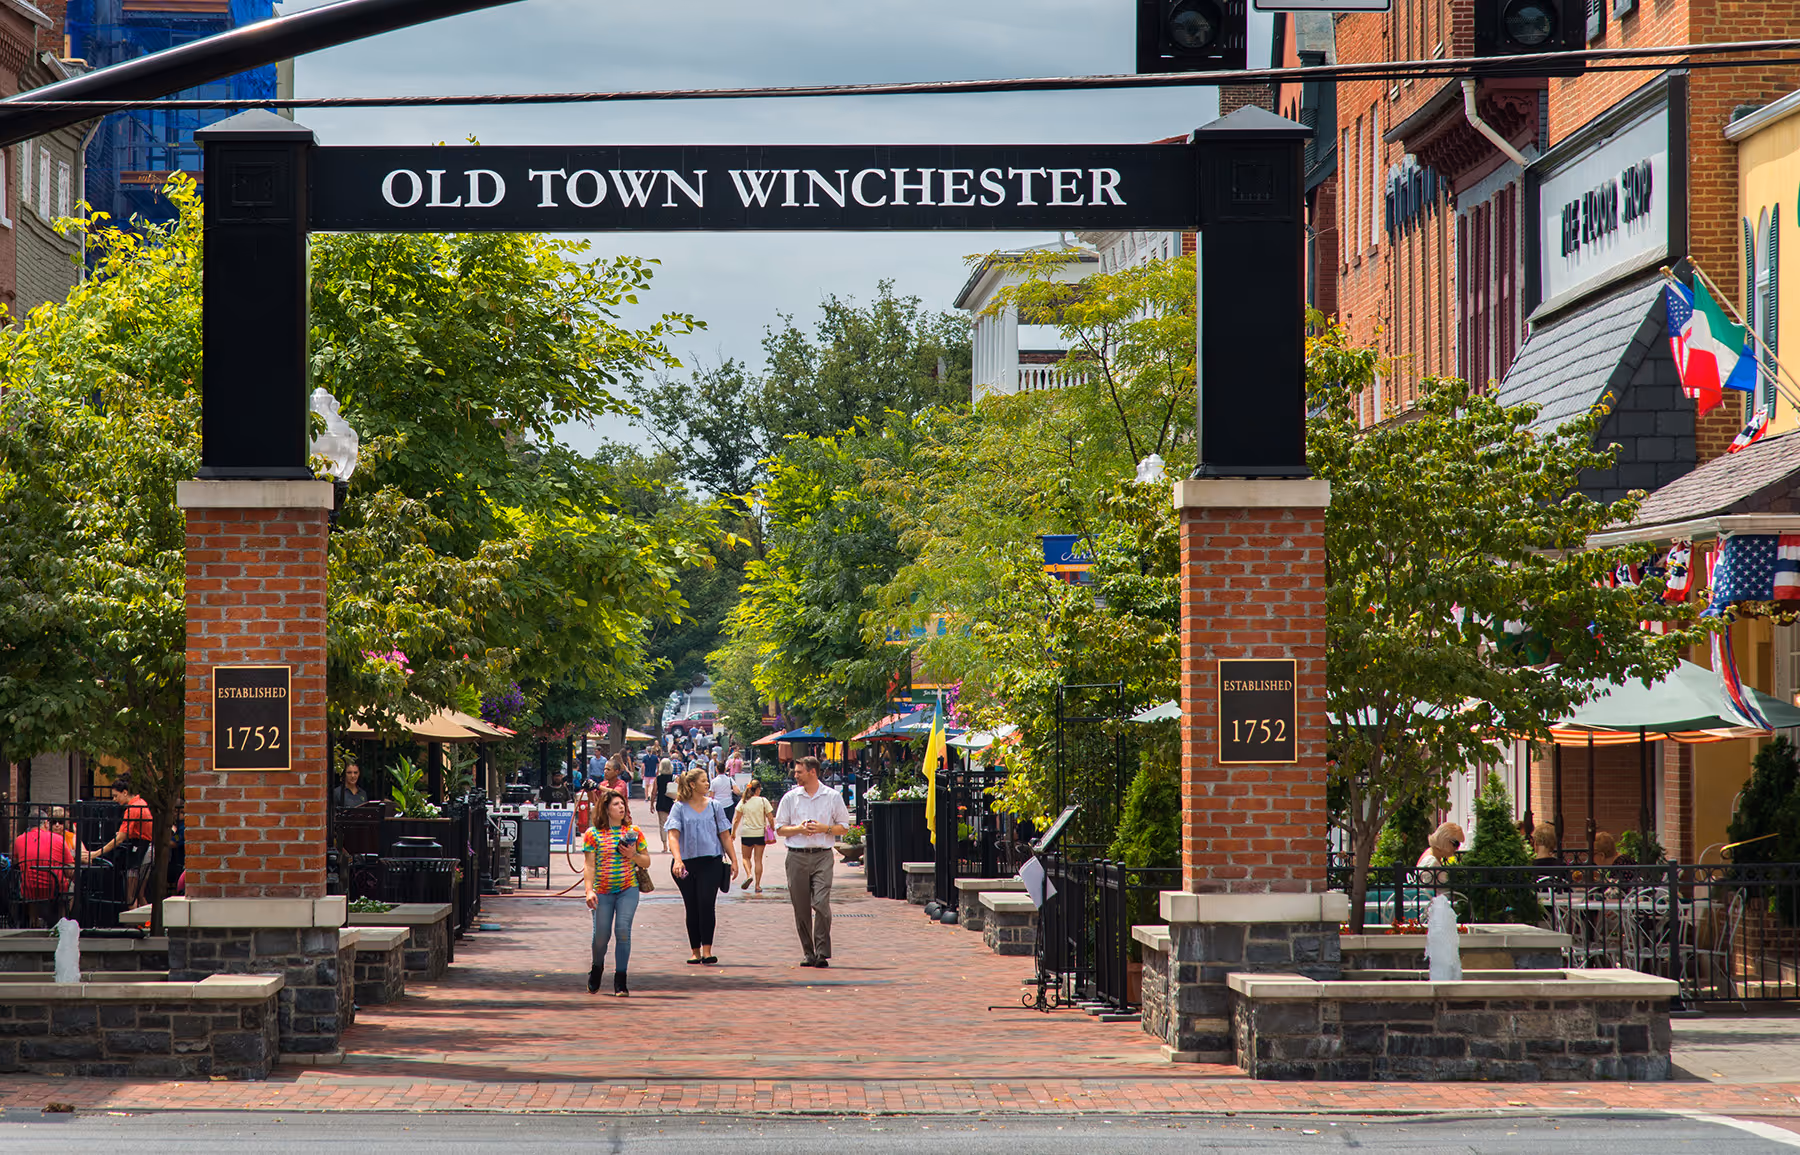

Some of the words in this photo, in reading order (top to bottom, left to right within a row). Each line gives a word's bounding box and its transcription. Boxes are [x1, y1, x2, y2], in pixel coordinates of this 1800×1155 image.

[381, 169, 506, 208] OLD
[528, 168, 708, 208] TOWN
[727, 166, 1127, 208] WINCHESTER
[1581, 178, 1618, 244] FLOOR
[1622, 159, 1652, 223] SHOP
[218, 688, 286, 698] ESTABLISHED
[1224, 680, 1292, 691] ESTABLISHED
[226, 725, 281, 752] 1752
[1232, 718, 1286, 744] 1752
